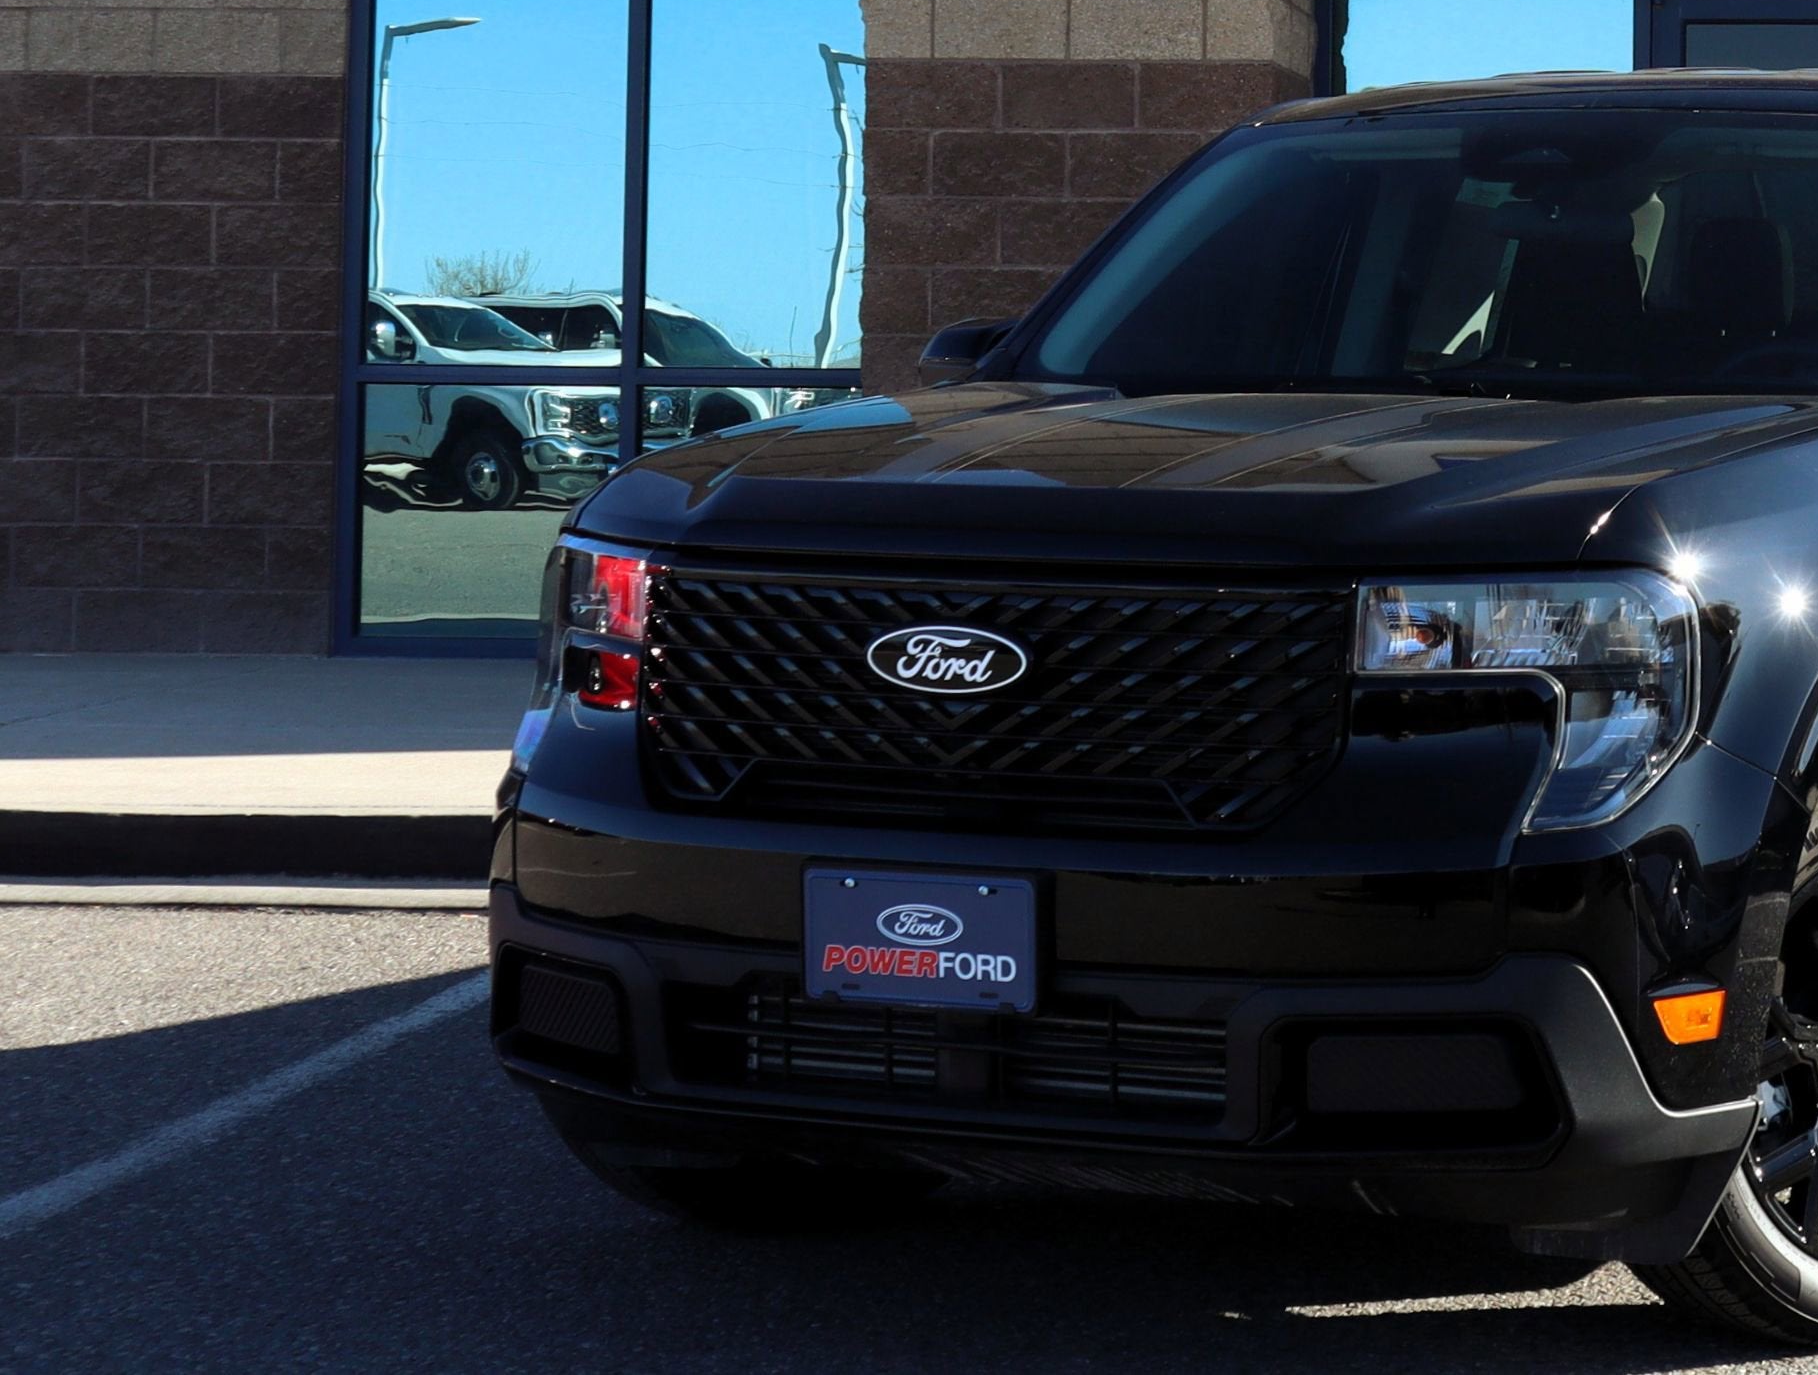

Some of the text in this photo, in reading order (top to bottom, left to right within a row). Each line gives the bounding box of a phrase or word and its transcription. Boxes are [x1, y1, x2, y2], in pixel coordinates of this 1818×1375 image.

[896, 634, 996, 683] Ford
[894, 910, 947, 937] Ford
[822, 944, 1017, 983] POWERFORD
